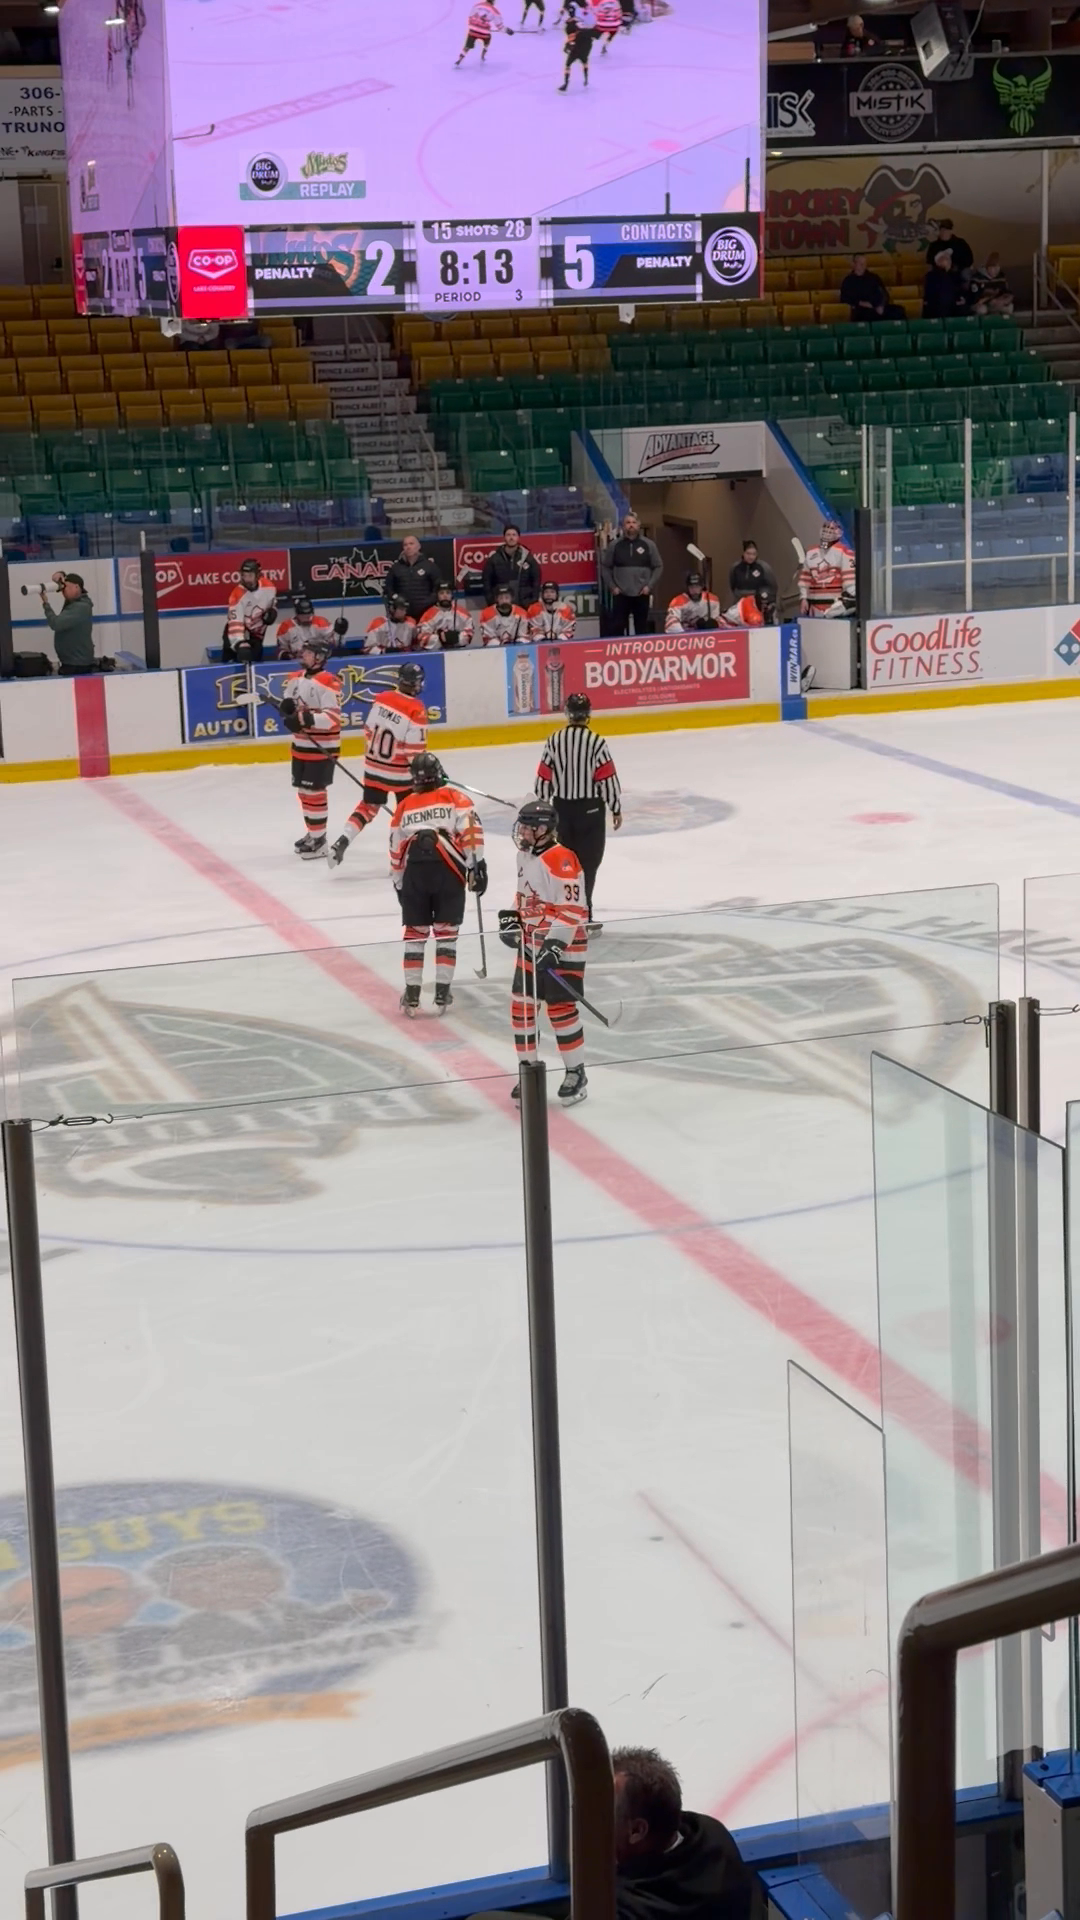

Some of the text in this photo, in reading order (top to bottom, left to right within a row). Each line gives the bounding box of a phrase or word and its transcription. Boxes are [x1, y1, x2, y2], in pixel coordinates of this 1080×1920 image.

[857, 92, 926, 113] MISTIK
[2, 121, 66, 134] TRUNO
[251, 170, 279, 179] DRUM
[255, 161, 272, 171] BIG
[300, 183, 355, 197] REPLAY
[431, 219, 525, 240] 15 SHOTS 28
[621, 222, 693, 241] CONTACTS
[766, 218, 851, 249] TOWN
[716, 238, 737, 250] BIG
[564, 235, 595, 290] 5
[636, 255, 693, 269] PENALTY
[712, 249, 746, 262] DRUM
[255, 266, 315, 280] PENALTY
[366, 240, 396, 296] 2
[440, 248, 514, 286] 8:13
[435, 288, 523, 302] PERIOD 3
[329, 556, 348, 564] THE
[464, 550, 496, 564] CO-
[550, 549, 595, 562] COUNT
[188, 572, 220, 585] LAKE
[222, 568, 286, 583] COTRY
[311, 560, 394, 582] CANAD
[870, 615, 982, 655] GoodLife
[606, 635, 716, 656] INTRODUCING
[585, 651, 737, 688] BODYARMOR
[873, 650, 981, 680] FITNESS
[194, 717, 279, 738] AUTO &
[369, 724, 395, 760] 10
[563, 883, 580, 902] 39
[56, 1500, 266, 1563] GUYS
